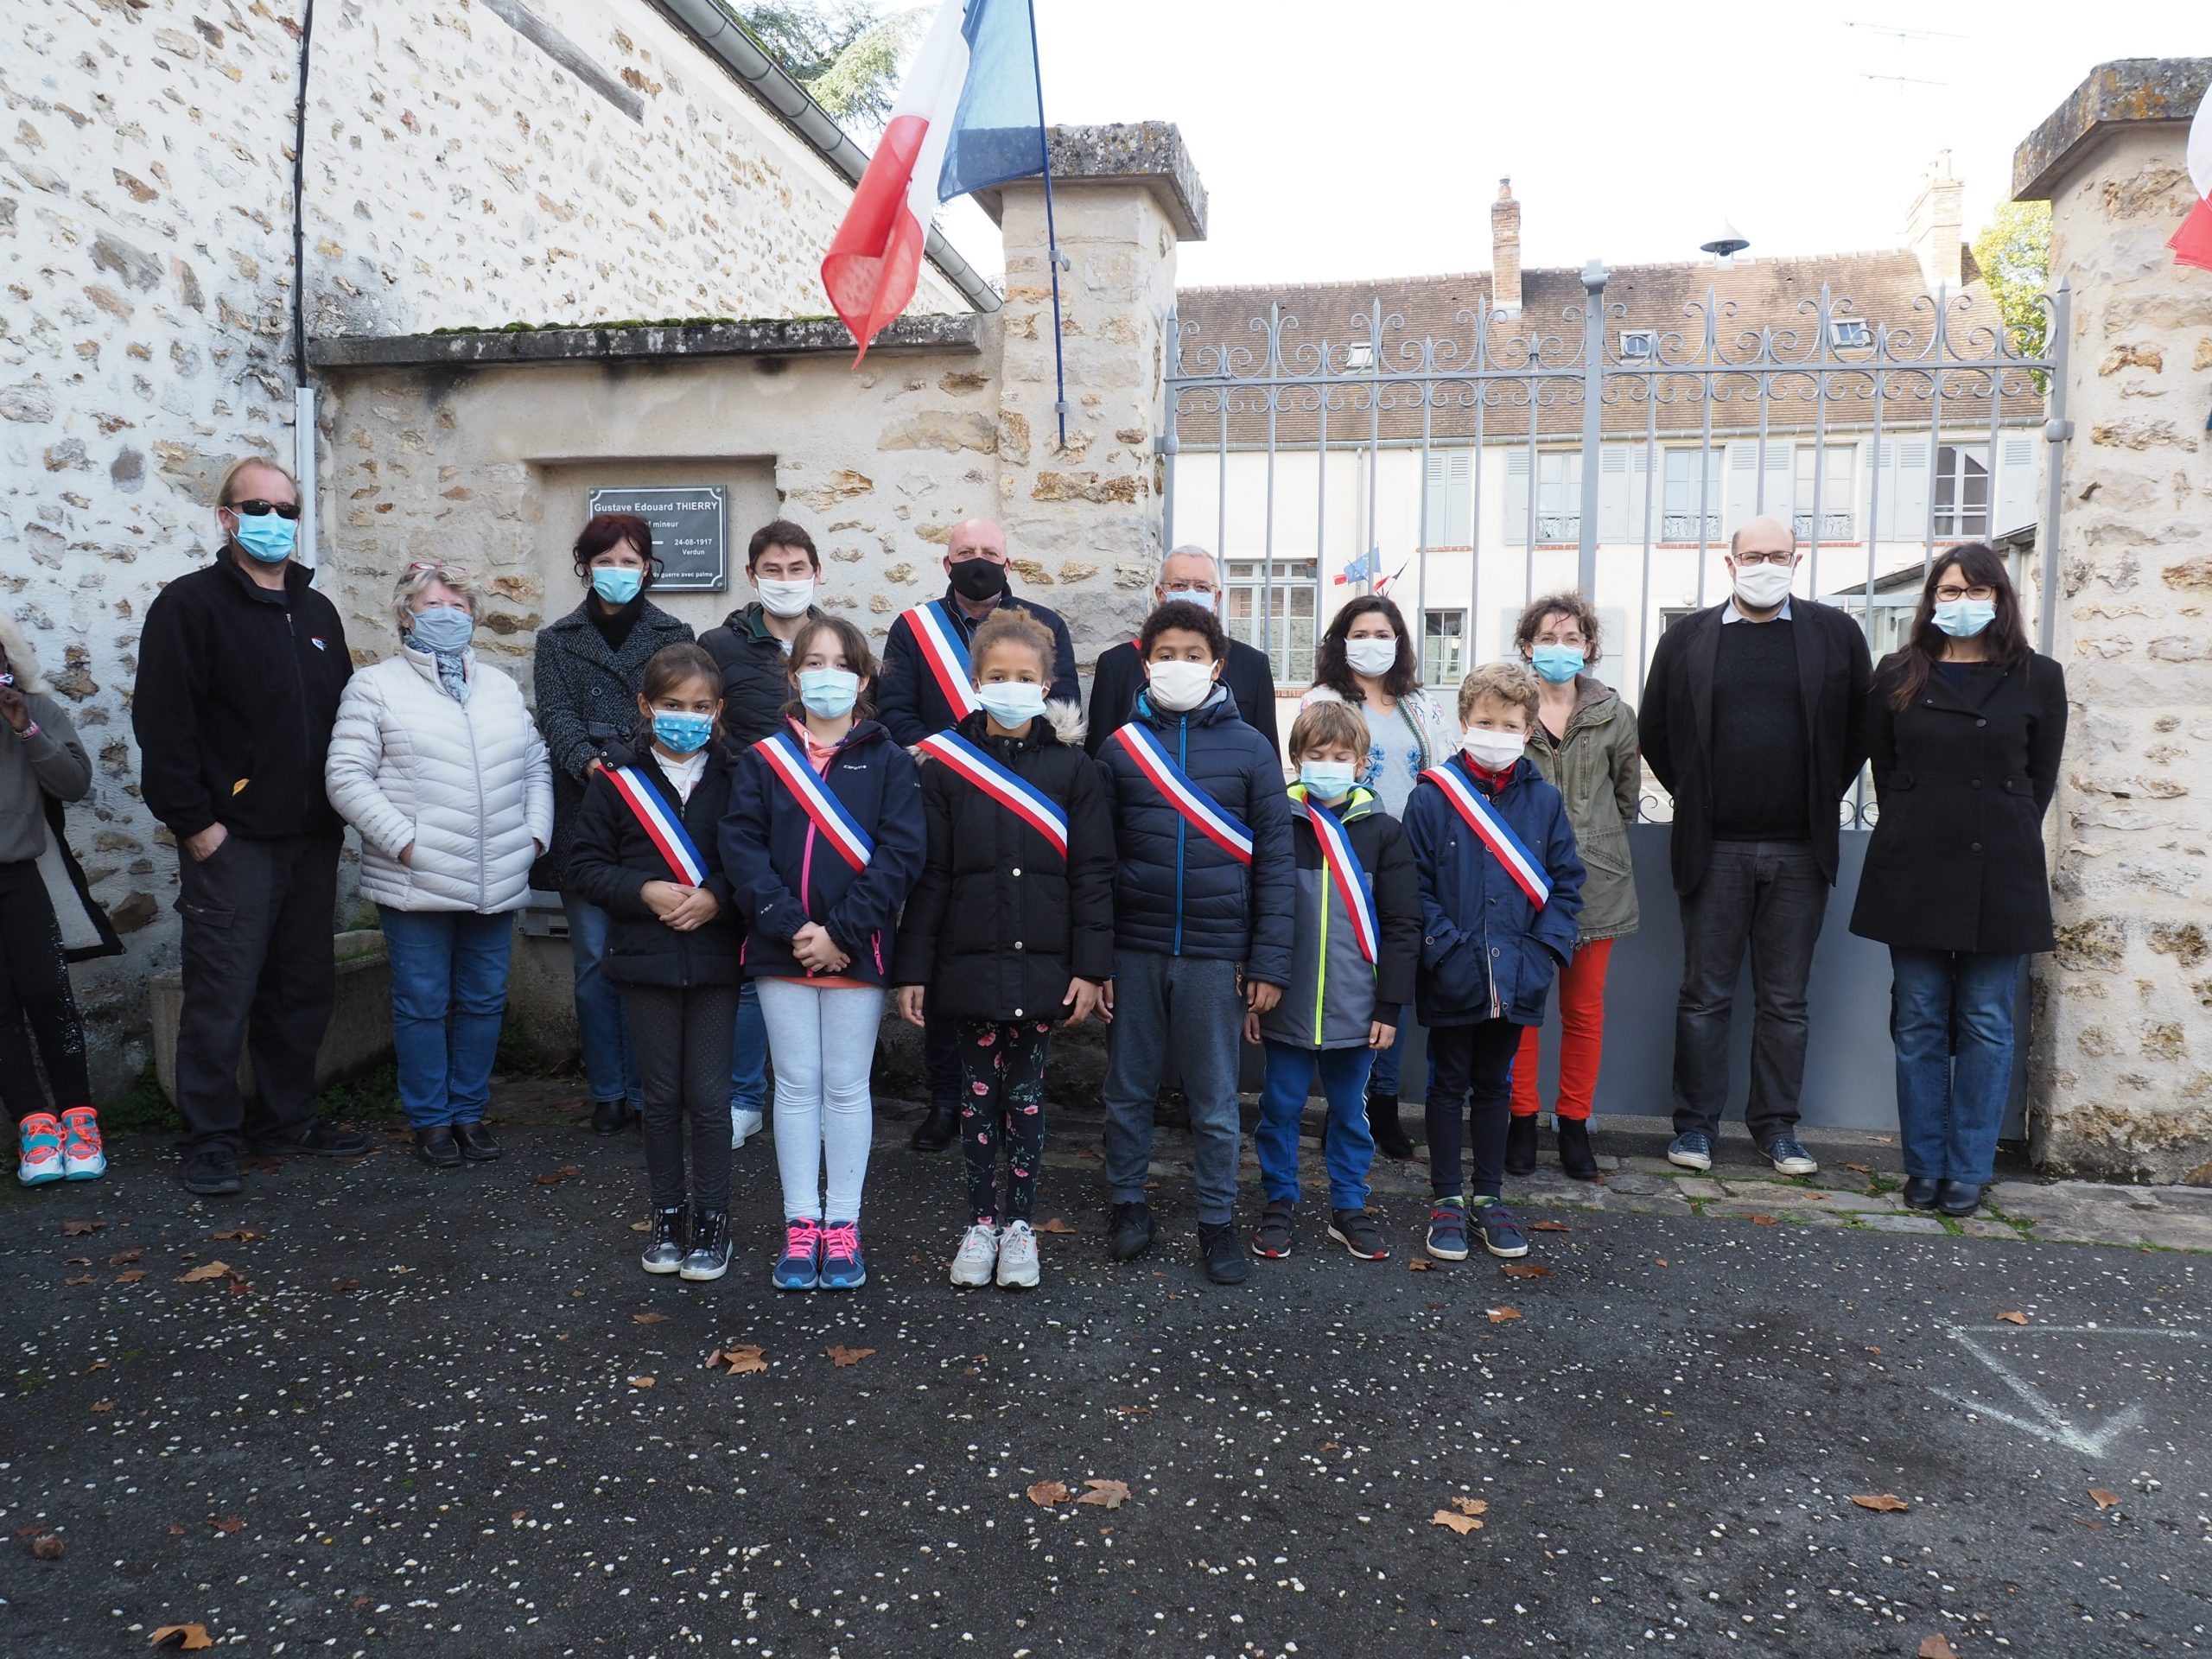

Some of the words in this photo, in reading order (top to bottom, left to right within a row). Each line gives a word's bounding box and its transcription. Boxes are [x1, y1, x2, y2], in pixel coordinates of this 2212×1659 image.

[594, 503, 632, 512] Gustave
[634, 502, 673, 511] Edouard
[676, 501, 717, 511] THIERRY
